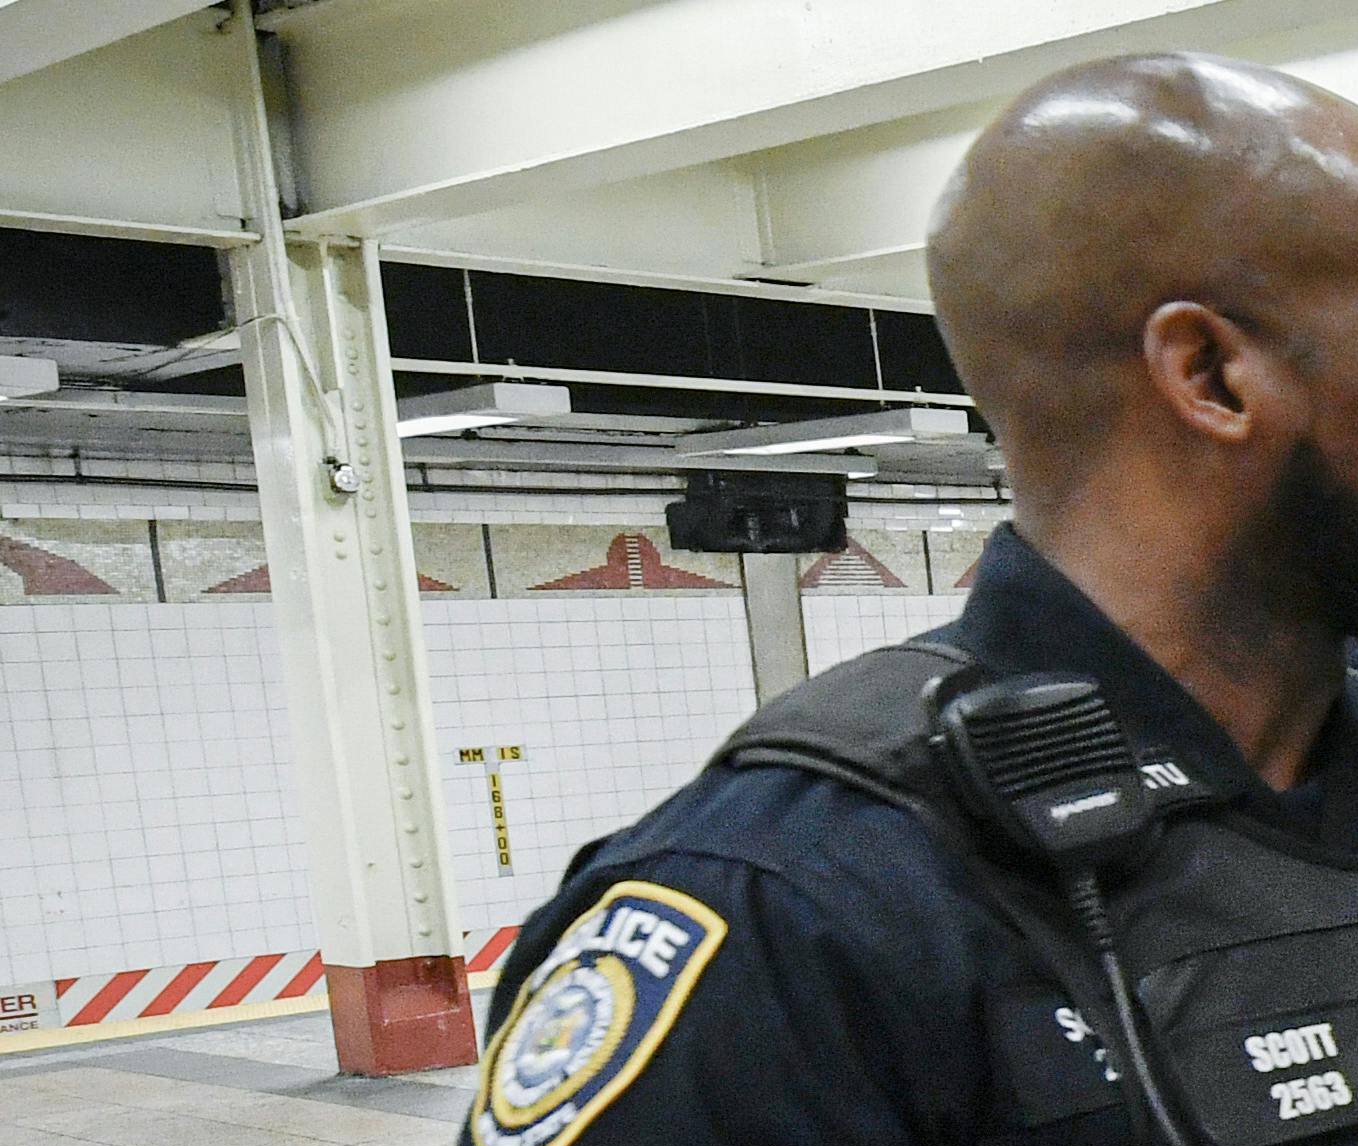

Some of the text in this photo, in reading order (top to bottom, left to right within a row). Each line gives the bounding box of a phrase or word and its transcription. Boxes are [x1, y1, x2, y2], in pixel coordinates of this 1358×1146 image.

[459, 748, 484, 762] MM
[1244, 1022, 1339, 1073] SCOTT
[1270, 1071, 1353, 1120] 2563
